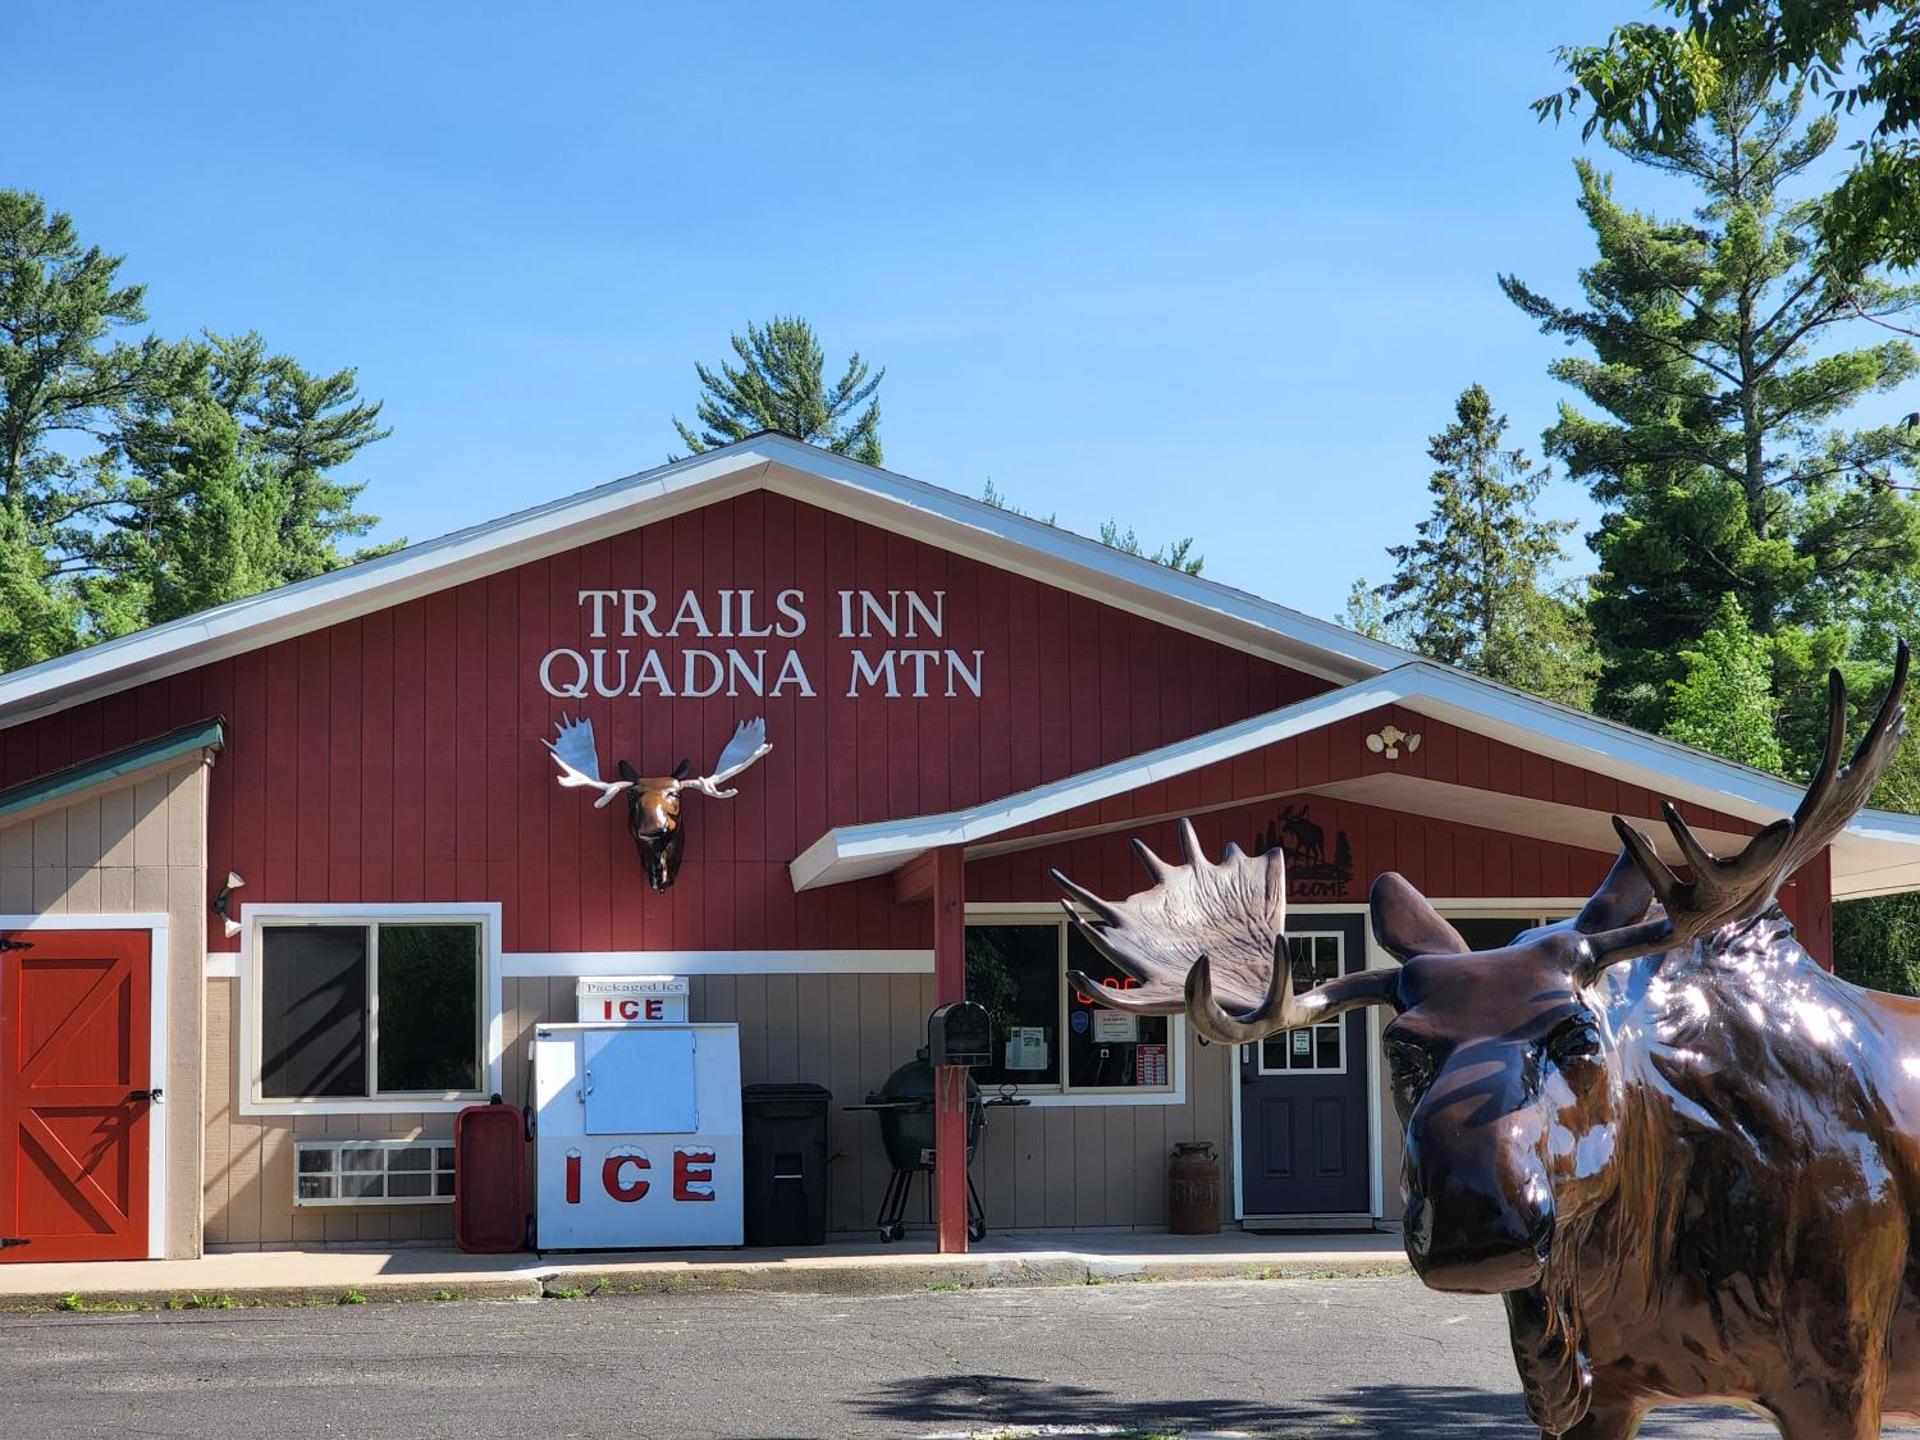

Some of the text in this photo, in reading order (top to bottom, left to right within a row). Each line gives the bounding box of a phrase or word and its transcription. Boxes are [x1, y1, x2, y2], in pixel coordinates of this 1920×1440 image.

[578, 588, 946, 639] TRAILS INN
[538, 647, 985, 699] QUADNA MTN
[587, 983, 683, 993] Packaged Ice
[603, 999, 663, 1020] ICE
[565, 1145, 716, 1204] ICE
